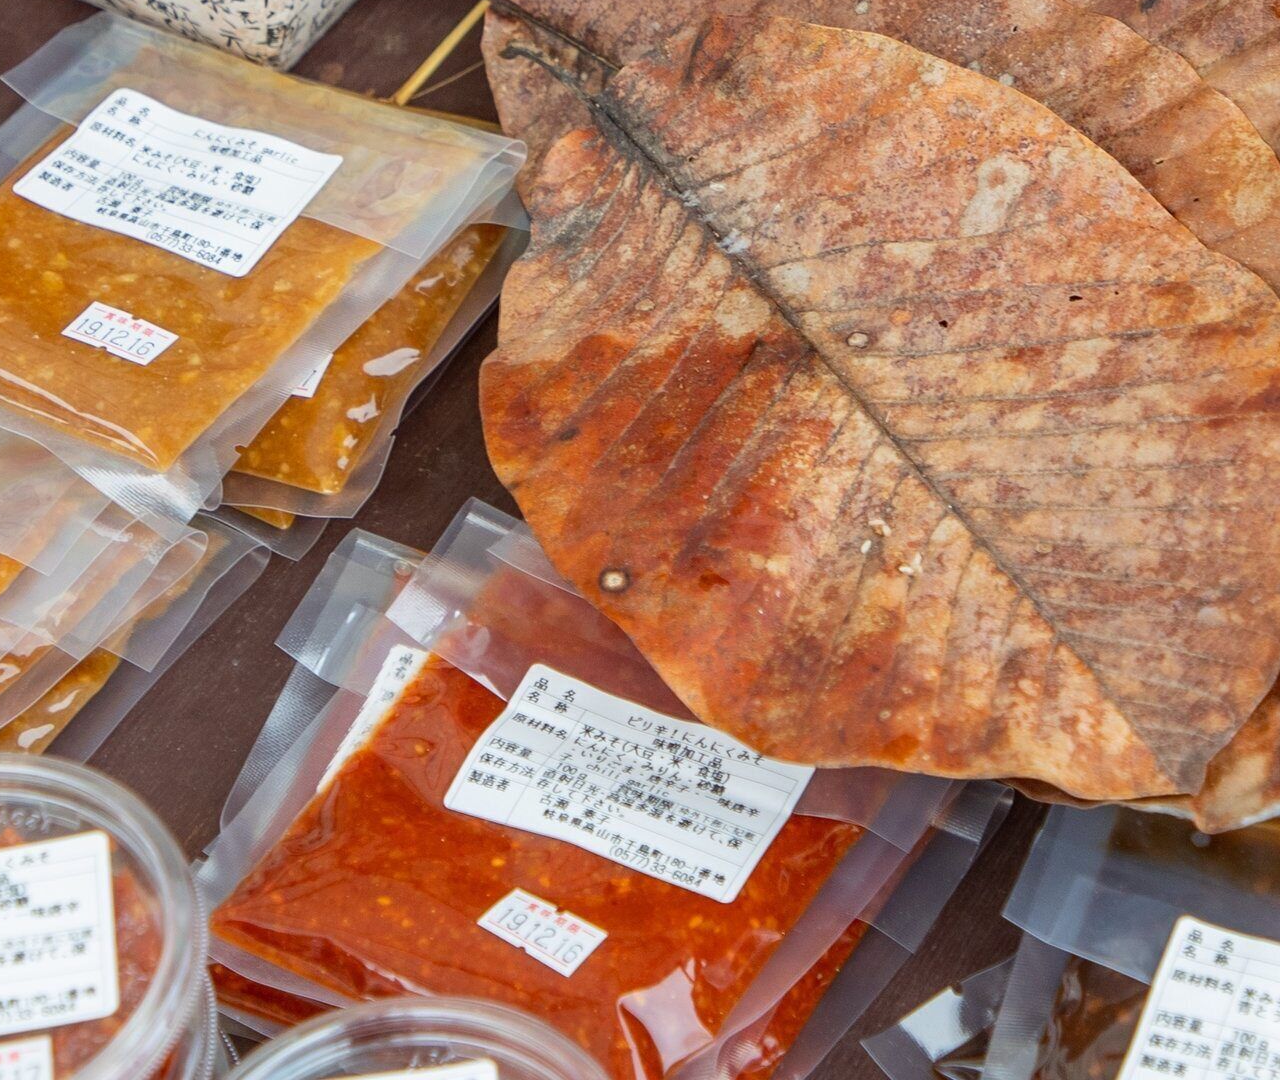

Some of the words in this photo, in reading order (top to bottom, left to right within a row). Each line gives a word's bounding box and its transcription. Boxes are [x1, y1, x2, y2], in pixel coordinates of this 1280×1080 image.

[260, 147, 298, 164] garlic
[76, 318, 155, 356] 19.12.16
[512, 712, 567, 740] 原材料名
[489, 738, 533, 760] 内容量
[479, 752, 536, 779] 保存方法
[467, 769, 510, 792] 製造者
[585, 763, 621, 779] chili
[625, 778, 670, 797] garlic
[496, 907, 584, 964] 19.12.16
[1171, 969, 1234, 995] 原材料名
